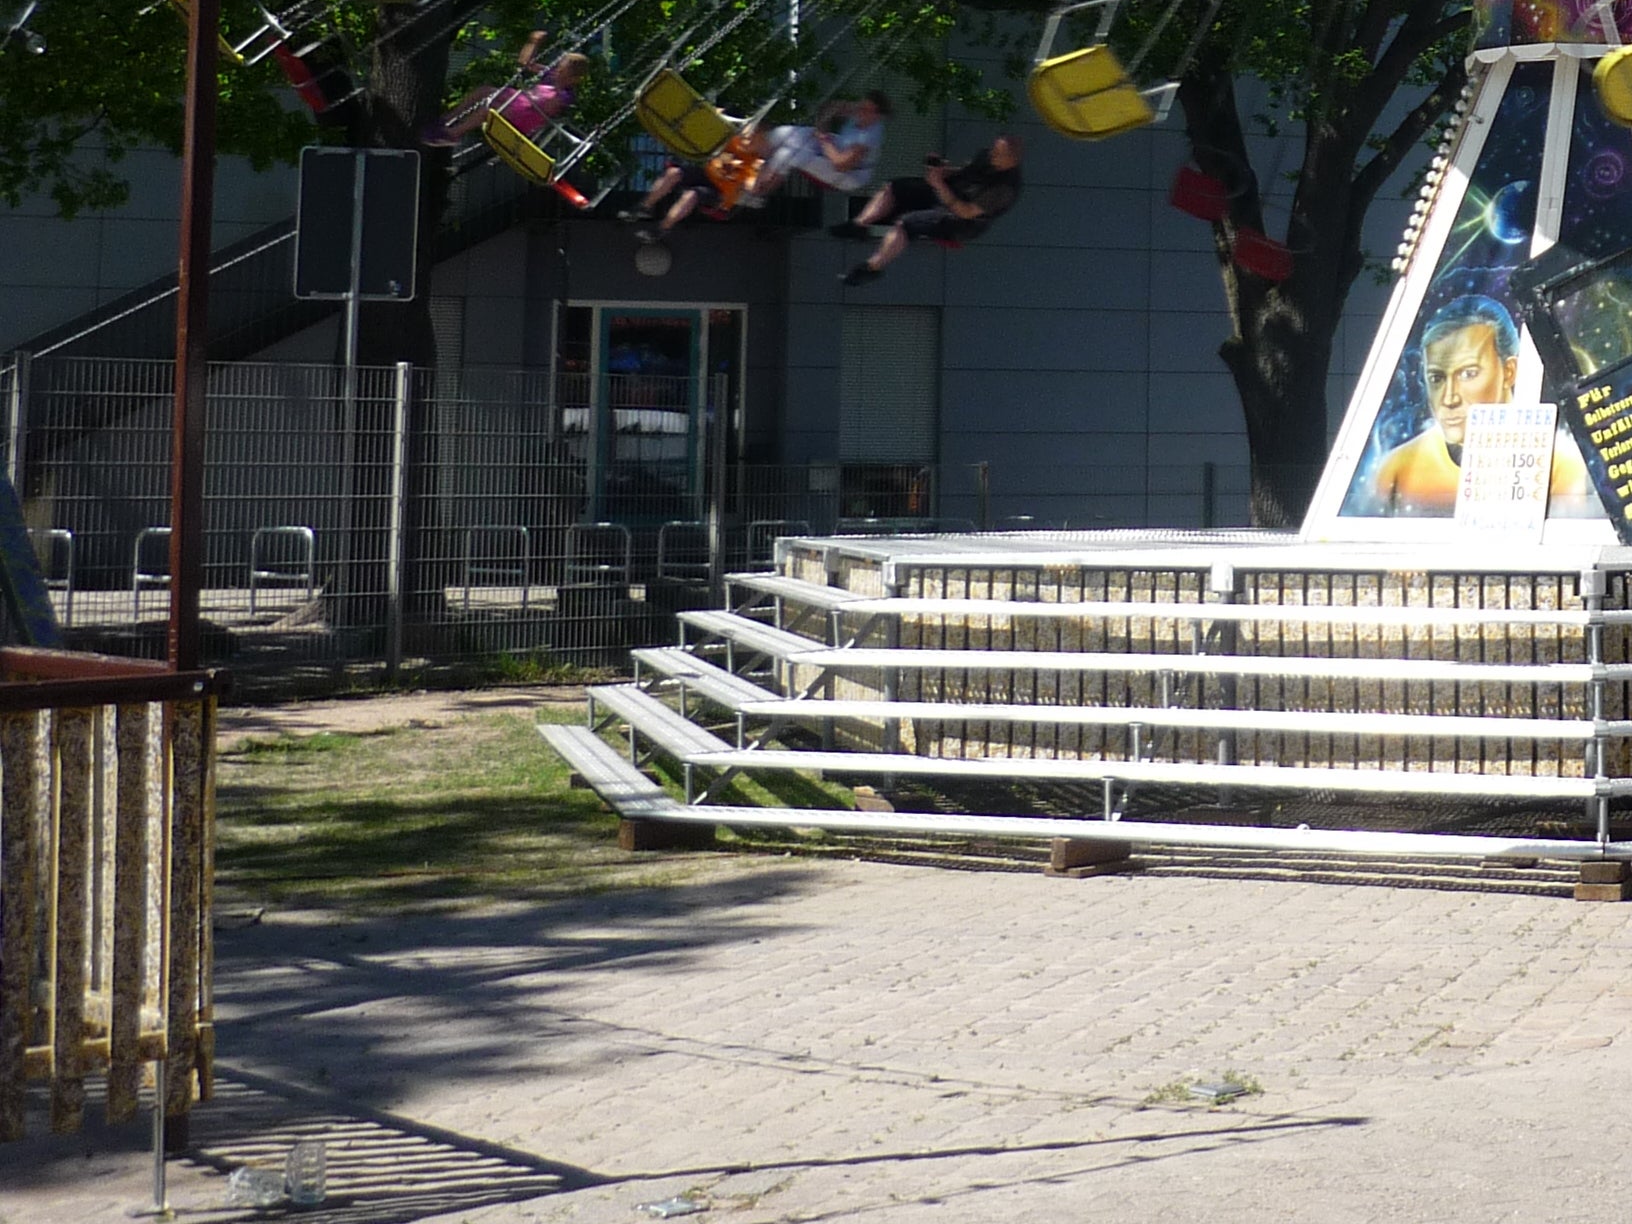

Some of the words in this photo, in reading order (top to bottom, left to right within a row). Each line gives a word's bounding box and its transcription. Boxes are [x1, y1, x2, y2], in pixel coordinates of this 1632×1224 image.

[1577, 385, 1612, 410] Für
[1471, 409, 1506, 425] STAR
[1517, 409, 1554, 425] TREK
